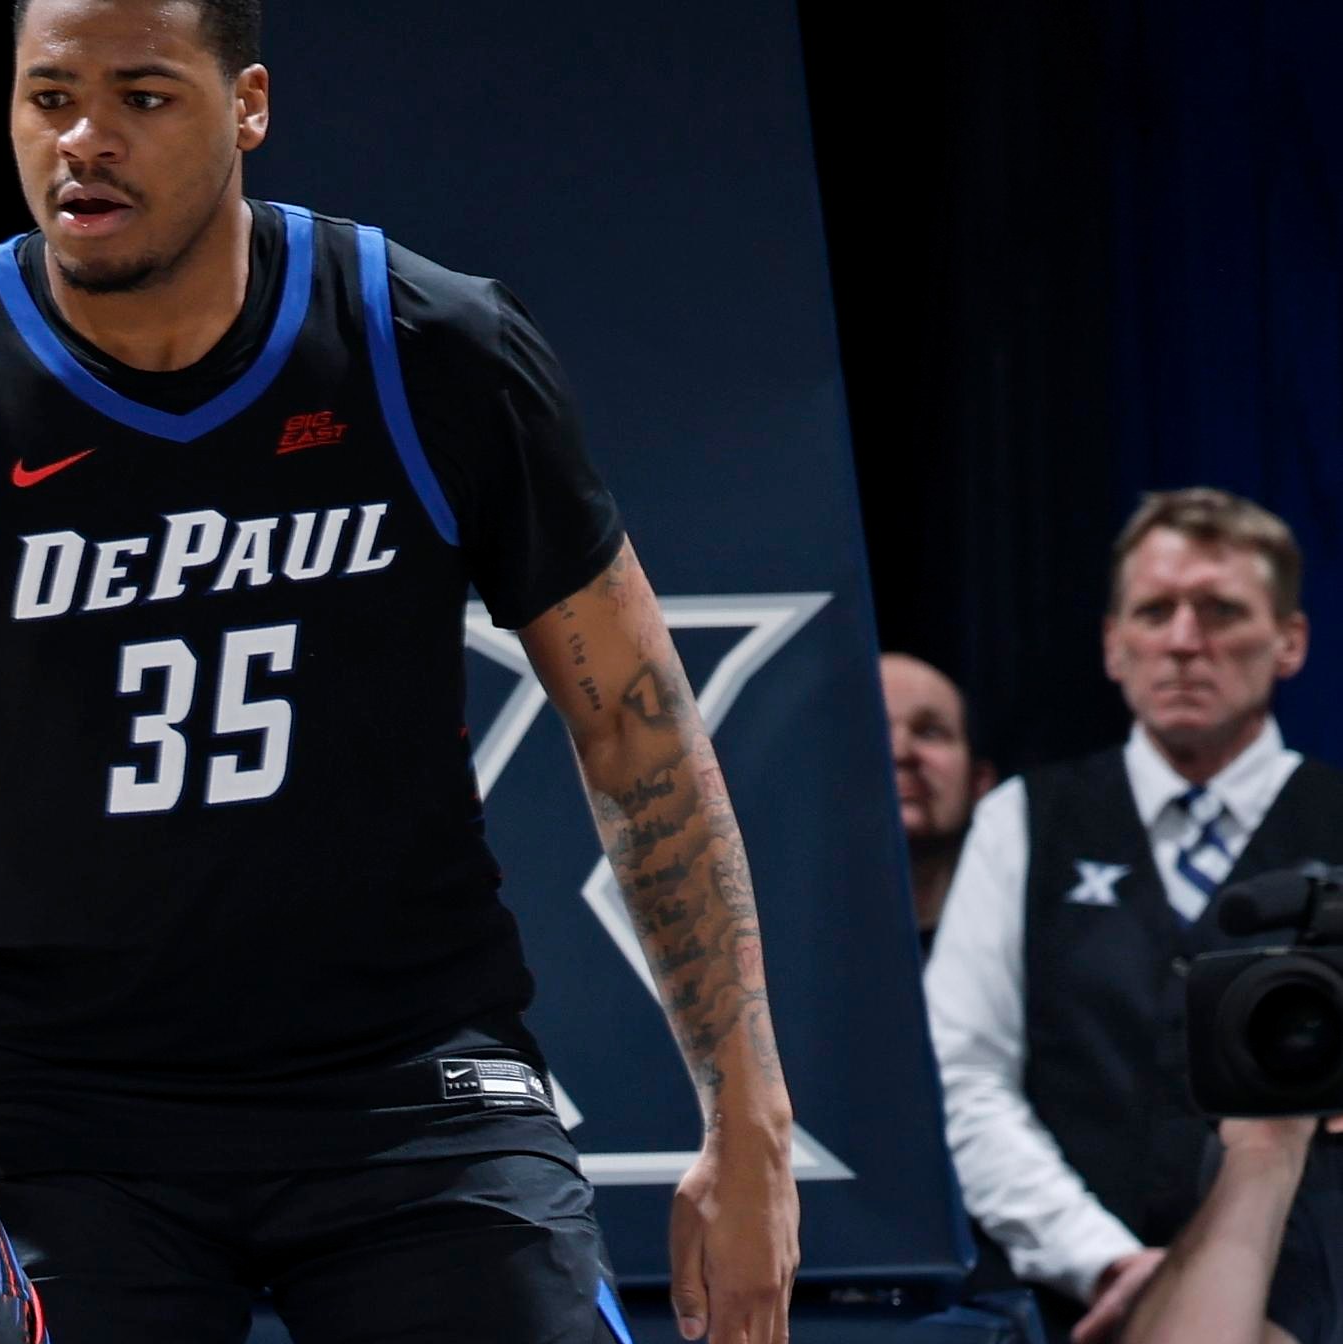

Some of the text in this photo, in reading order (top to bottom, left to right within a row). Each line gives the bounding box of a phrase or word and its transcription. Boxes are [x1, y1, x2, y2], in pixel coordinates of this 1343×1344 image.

[285, 411, 333, 431] BIG
[279, 424, 349, 445] EAST
[106, 622, 301, 815] 35
